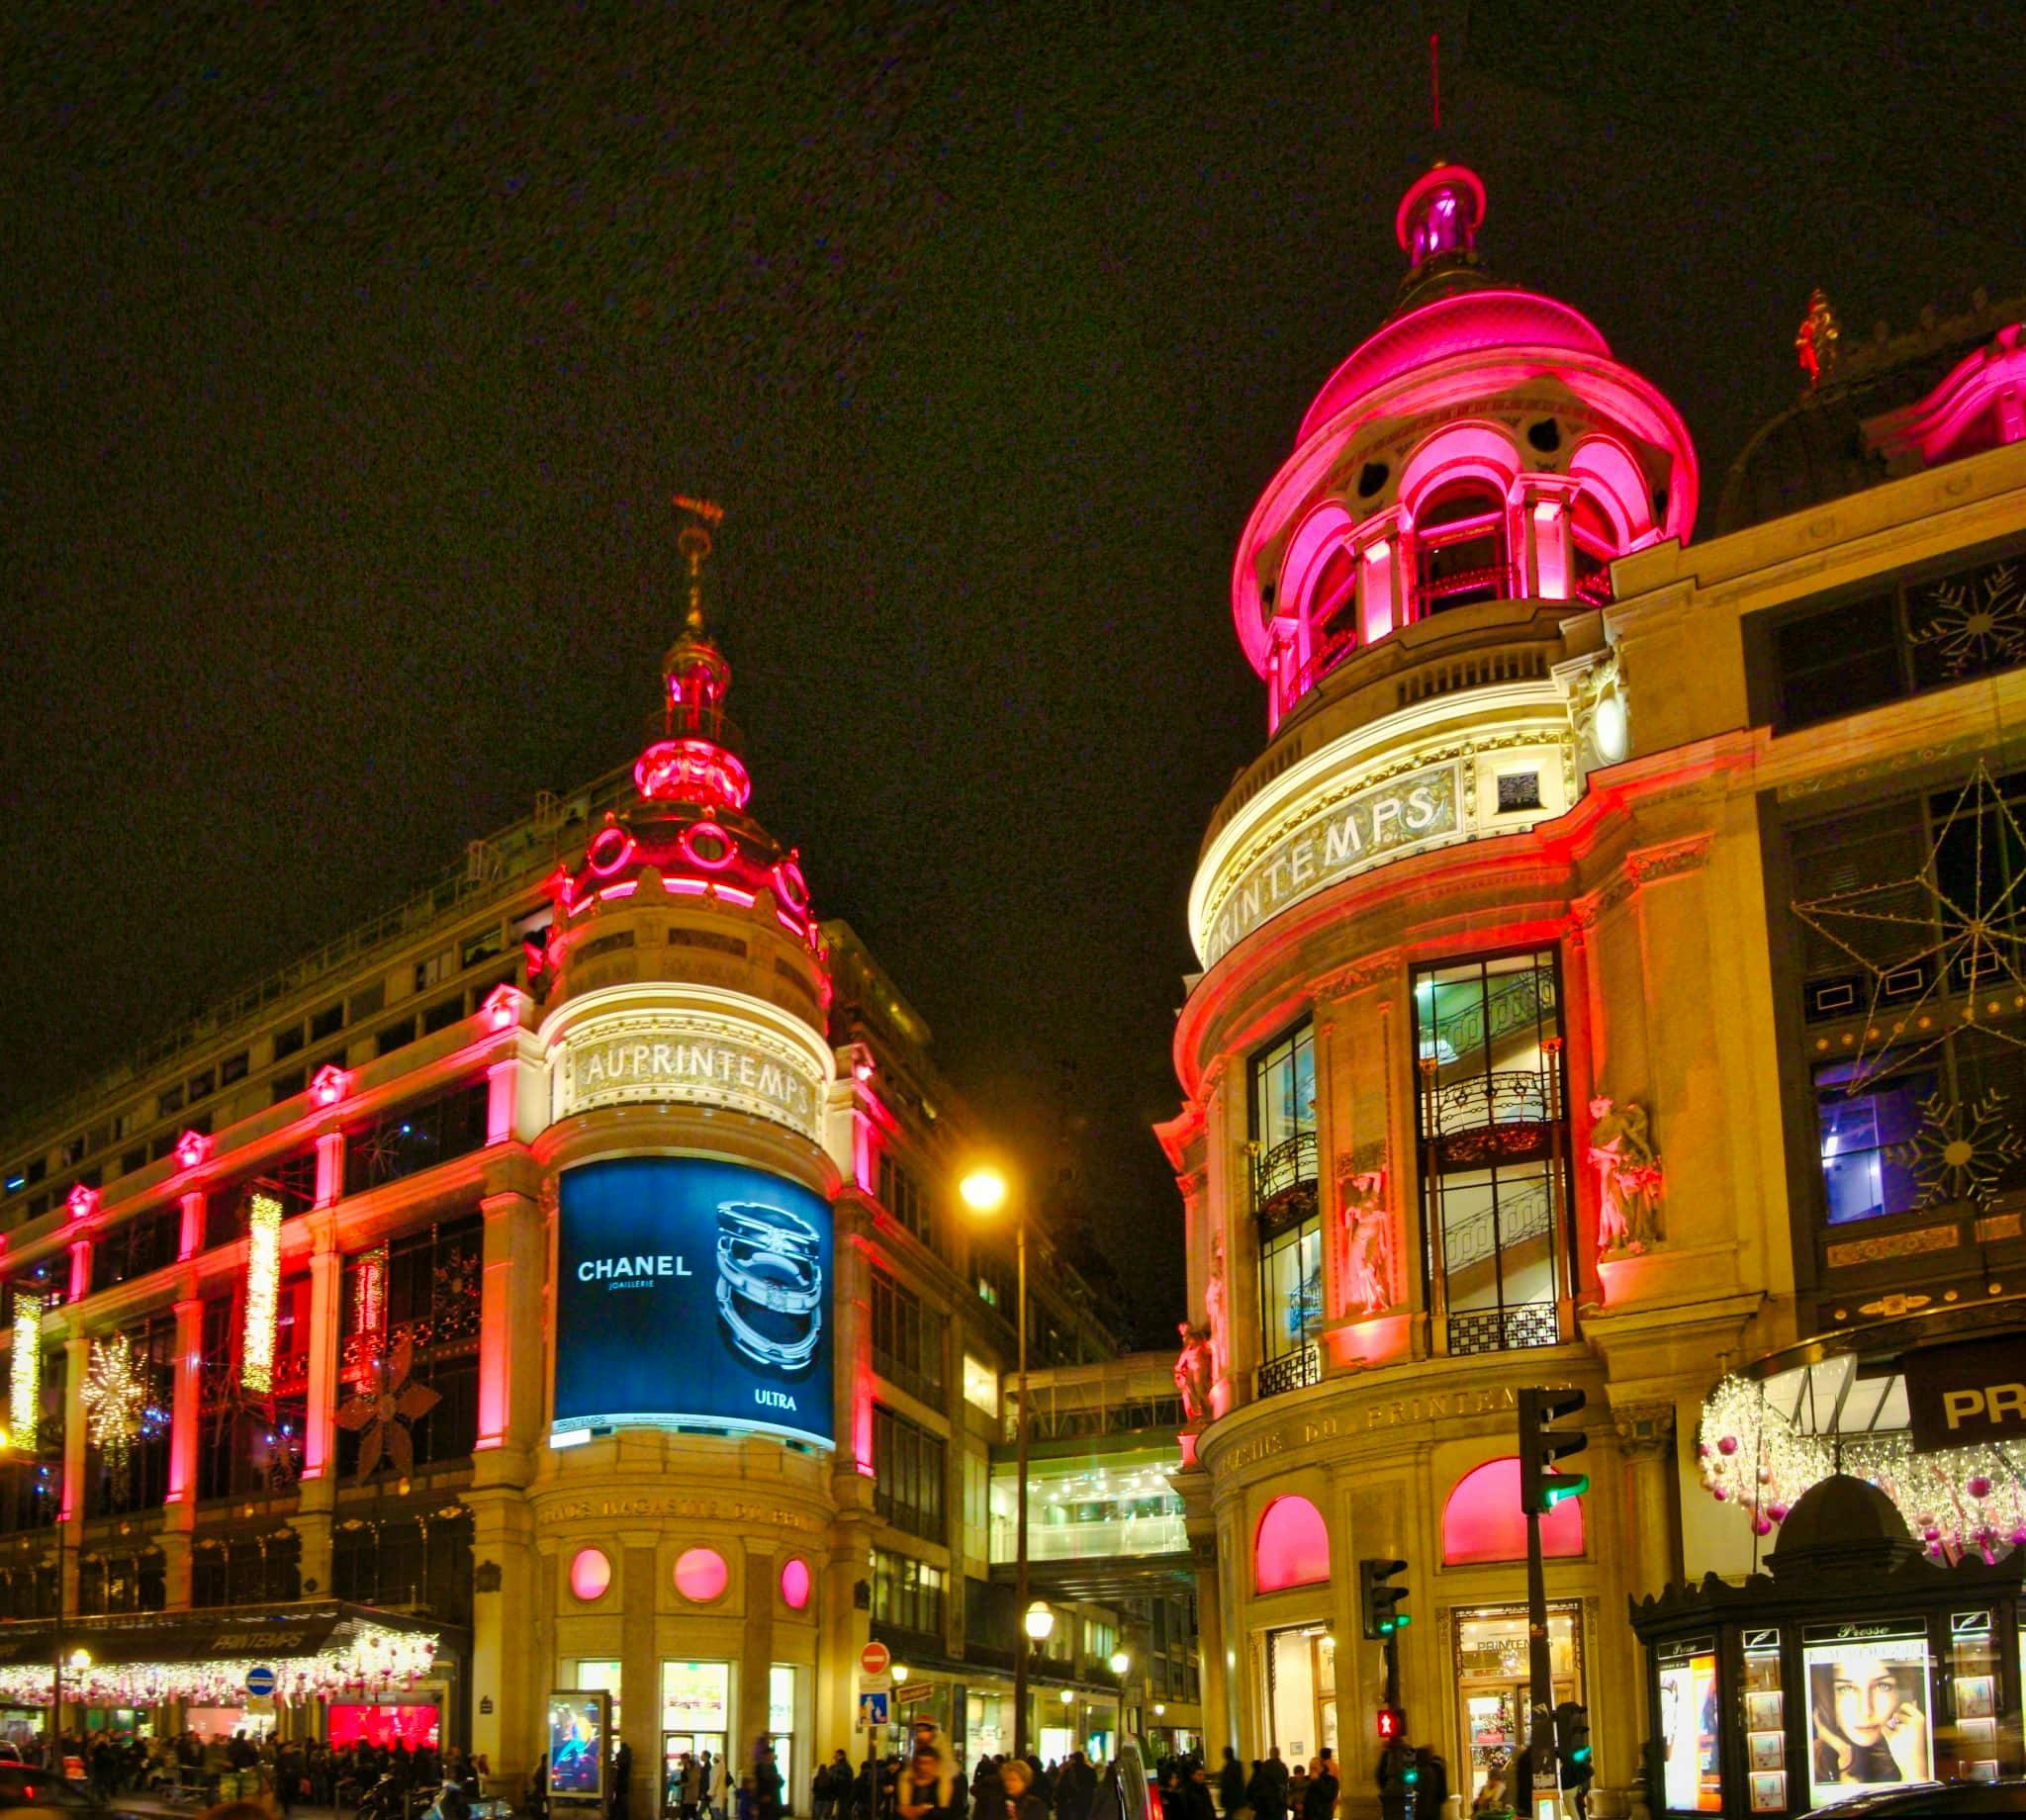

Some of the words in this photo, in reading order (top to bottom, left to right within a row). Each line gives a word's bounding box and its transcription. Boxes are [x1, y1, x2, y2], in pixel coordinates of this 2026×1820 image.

[578, 1255, 692, 1282] CHANEL
[609, 1280, 654, 1290] JOAILLERIE
[754, 1389, 796, 1411] ULTRA
[1943, 1383, 2026, 1429] PR
[1305, 1415, 1336, 1443] DU
[1837, 1623, 1891, 1638] Presse
